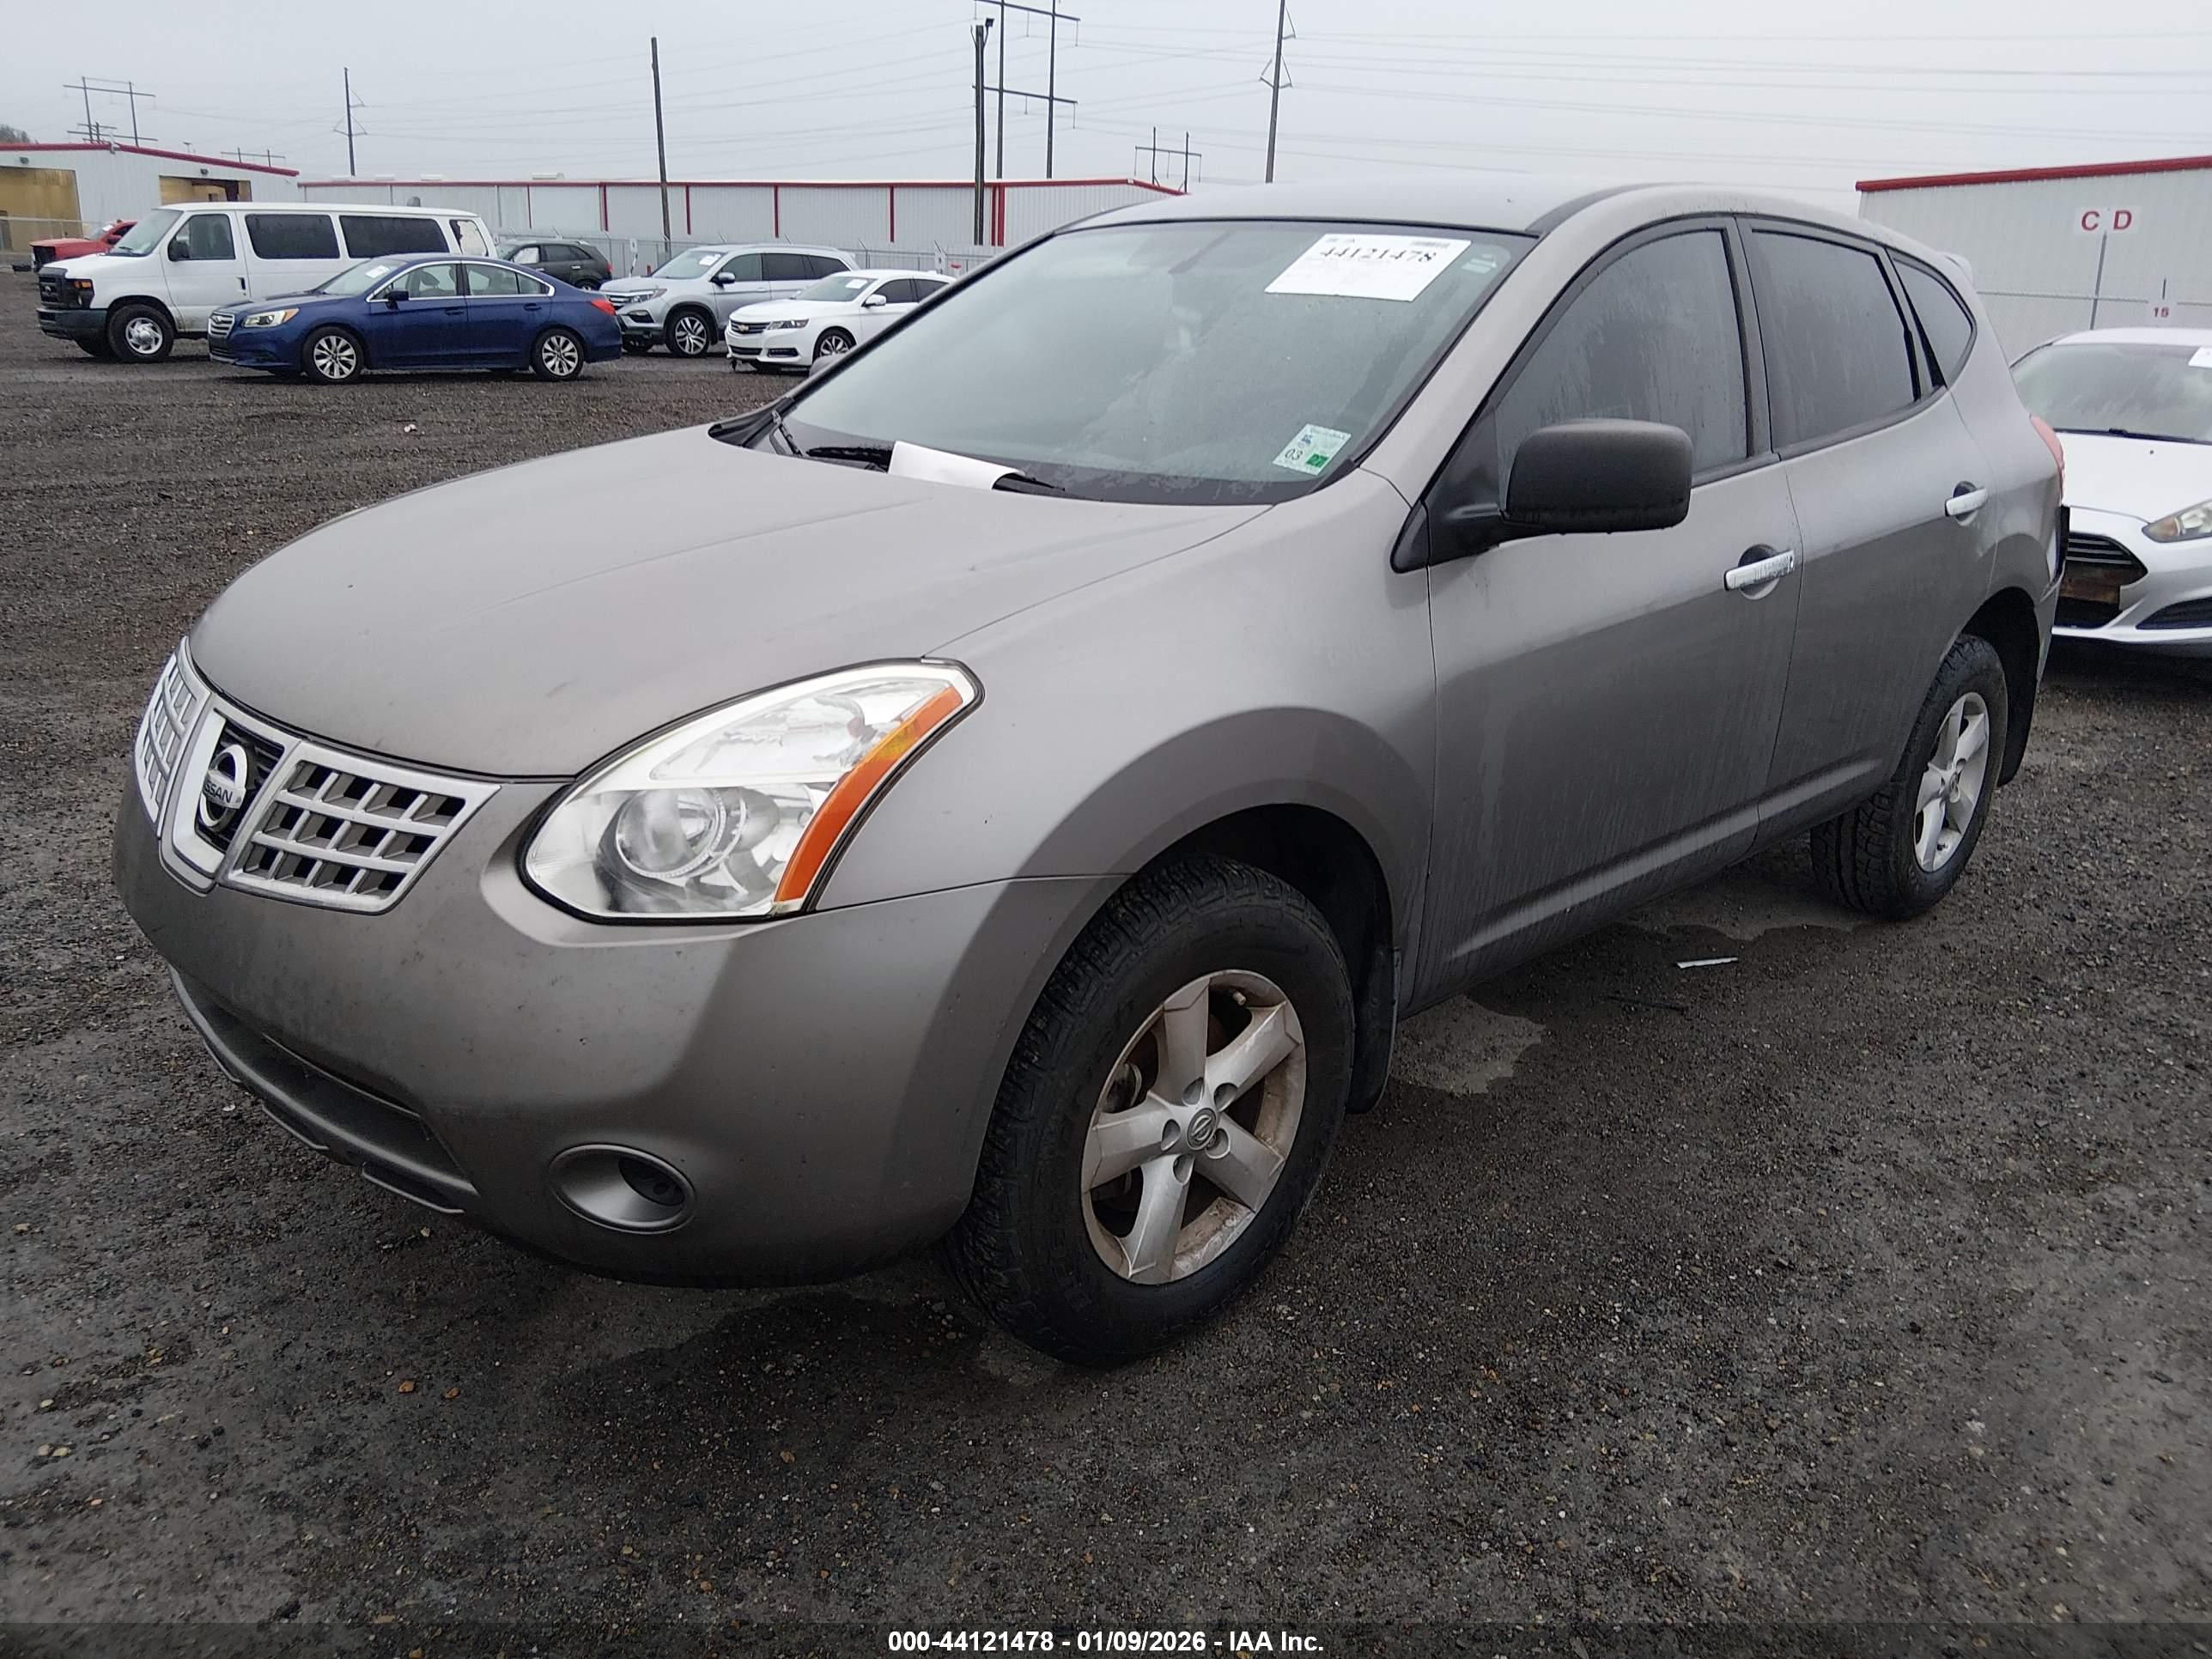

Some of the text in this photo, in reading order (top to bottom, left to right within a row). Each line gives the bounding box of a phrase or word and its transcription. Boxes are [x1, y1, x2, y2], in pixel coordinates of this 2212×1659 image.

[2081, 210, 2132, 231] C D
[204, 780, 233, 804] SSAN
